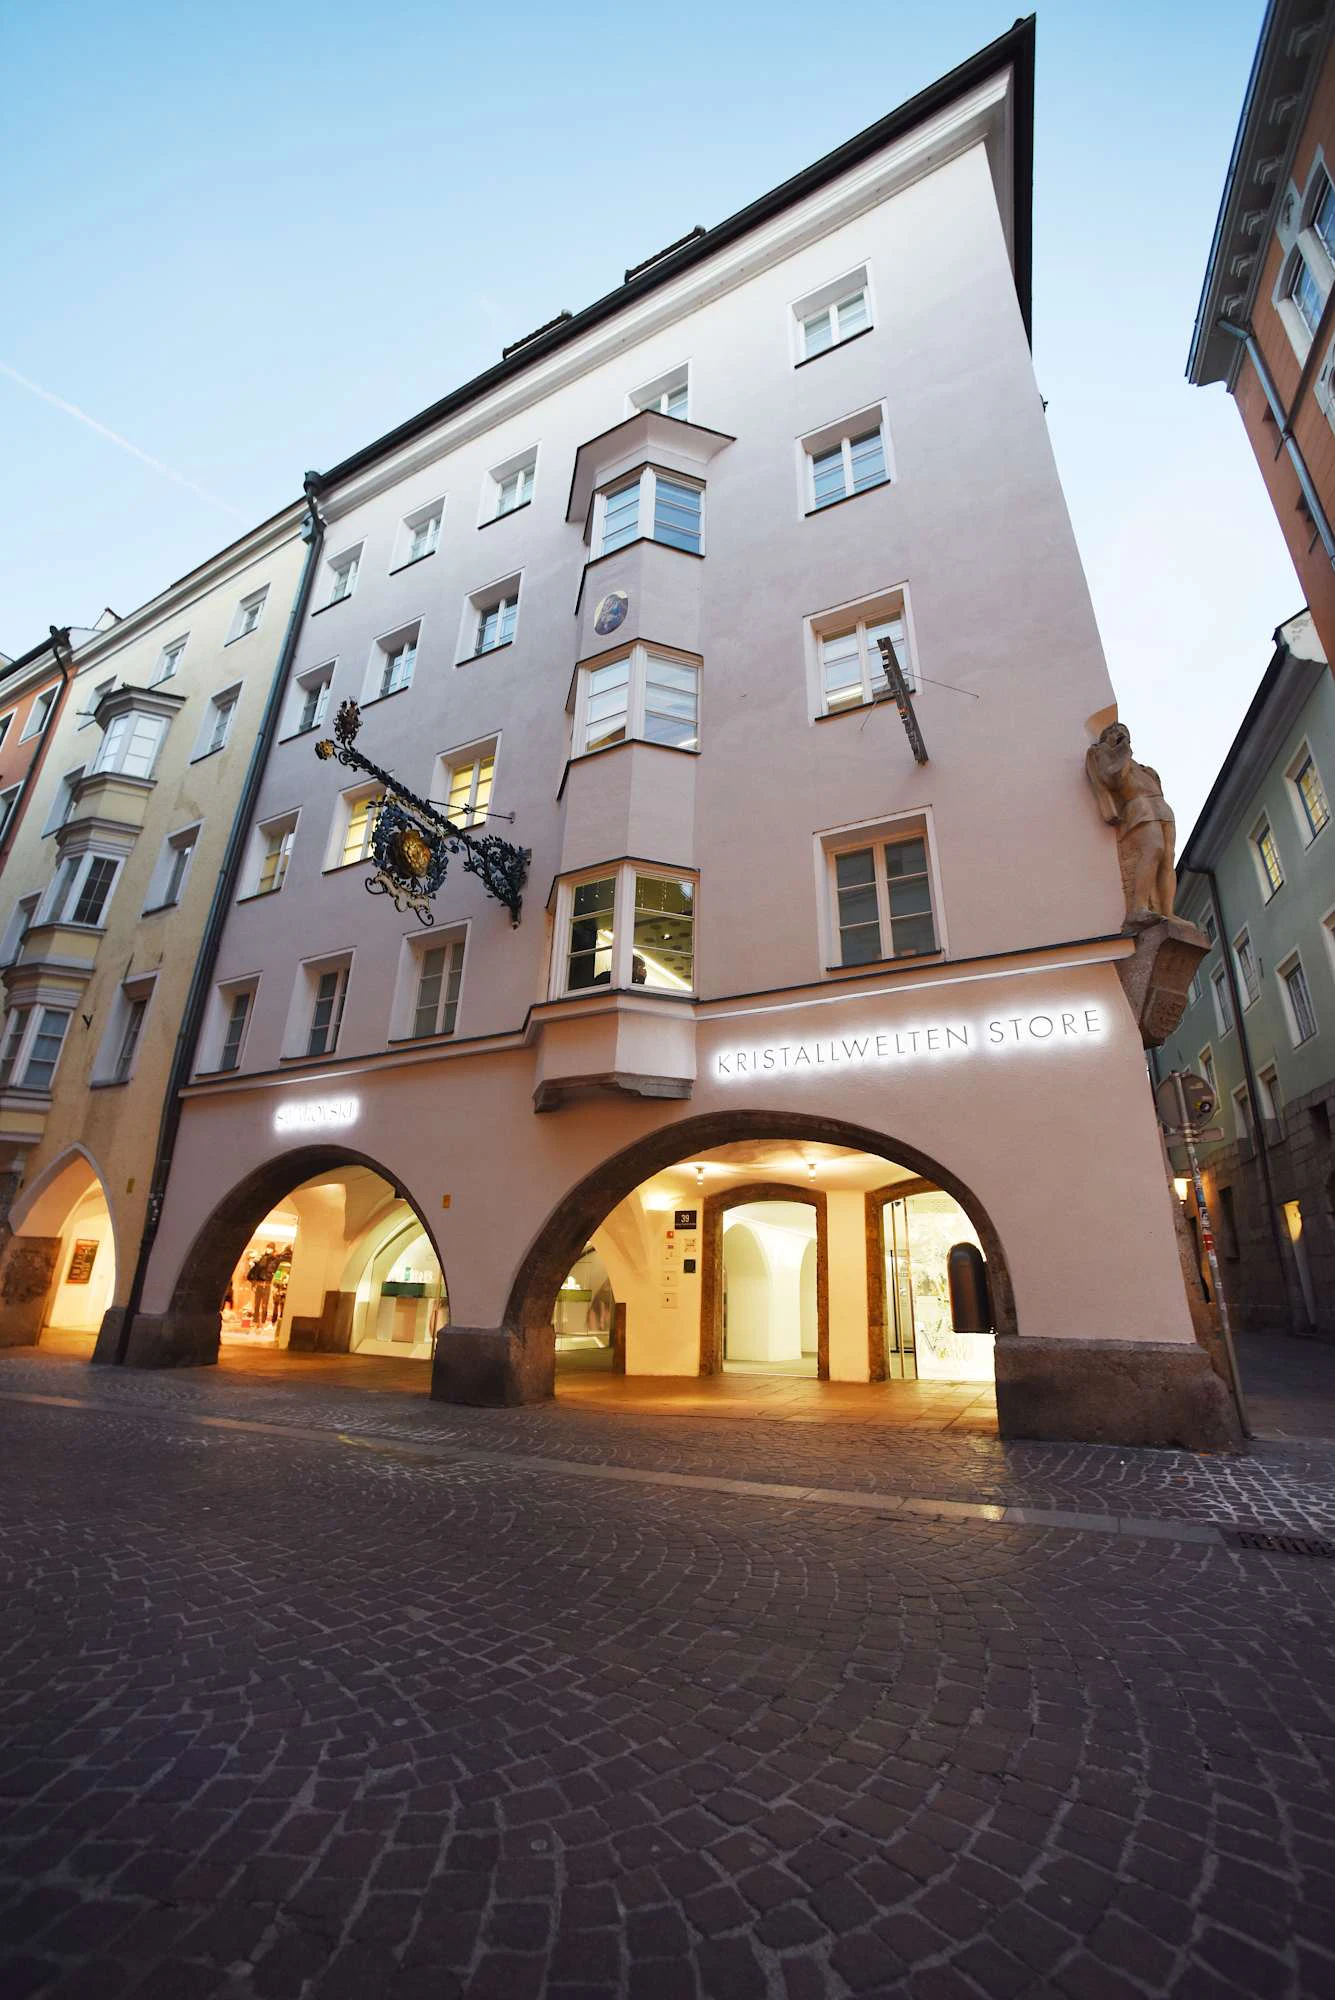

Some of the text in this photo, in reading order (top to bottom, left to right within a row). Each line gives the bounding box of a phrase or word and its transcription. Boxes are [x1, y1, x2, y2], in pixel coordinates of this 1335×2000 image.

[718, 1009, 1100, 1073] KRISTALLWELTEN STORE
[681, 1214, 690, 1222] 39
